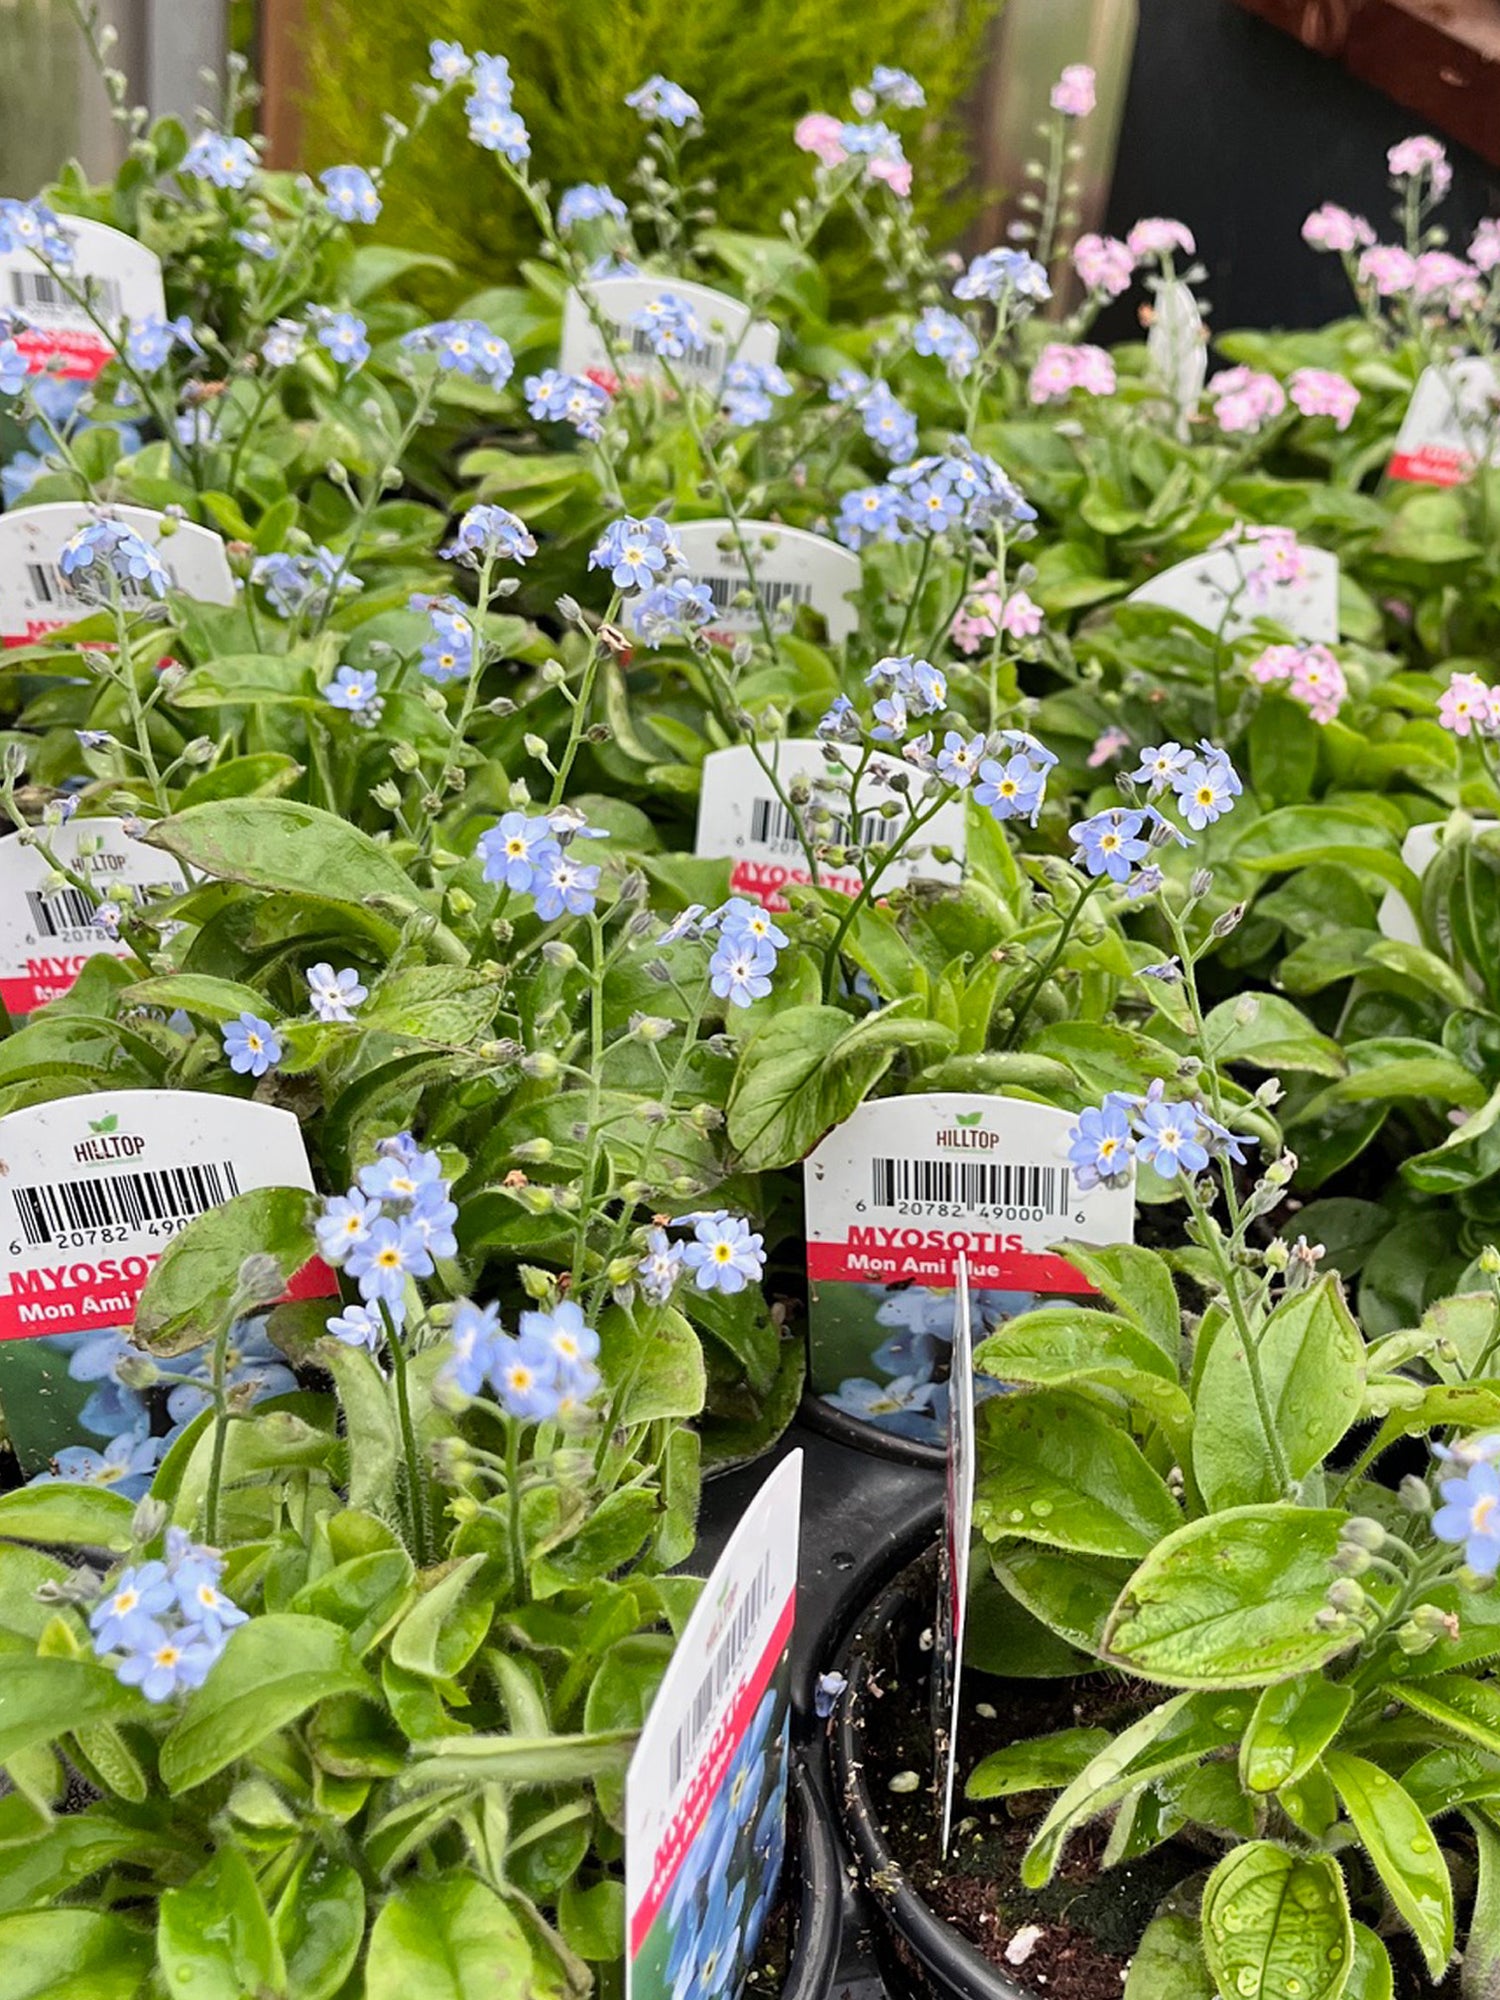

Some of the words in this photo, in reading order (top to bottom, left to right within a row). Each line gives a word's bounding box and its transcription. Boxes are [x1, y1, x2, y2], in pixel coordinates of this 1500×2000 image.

[73, 1136, 145, 1162] HILLTOP
[936, 1129, 1000, 1149] HILLTOP
[856, 1199, 867, 1213] 6
[899, 1201, 963, 1218] 20782
[979, 1206, 1044, 1222] 49000
[1075, 1210, 1086, 1224] 6
[9, 1240, 22, 1256] 6
[56, 1226, 129, 1250] 20782
[848, 1224, 1025, 1254] MYOSOTIS
[847, 1252, 897, 1272] Mon
[901, 1256, 947, 1275] Ami
[17, 1302, 76, 1323] Mon
[82, 1290, 132, 1315] Ami
